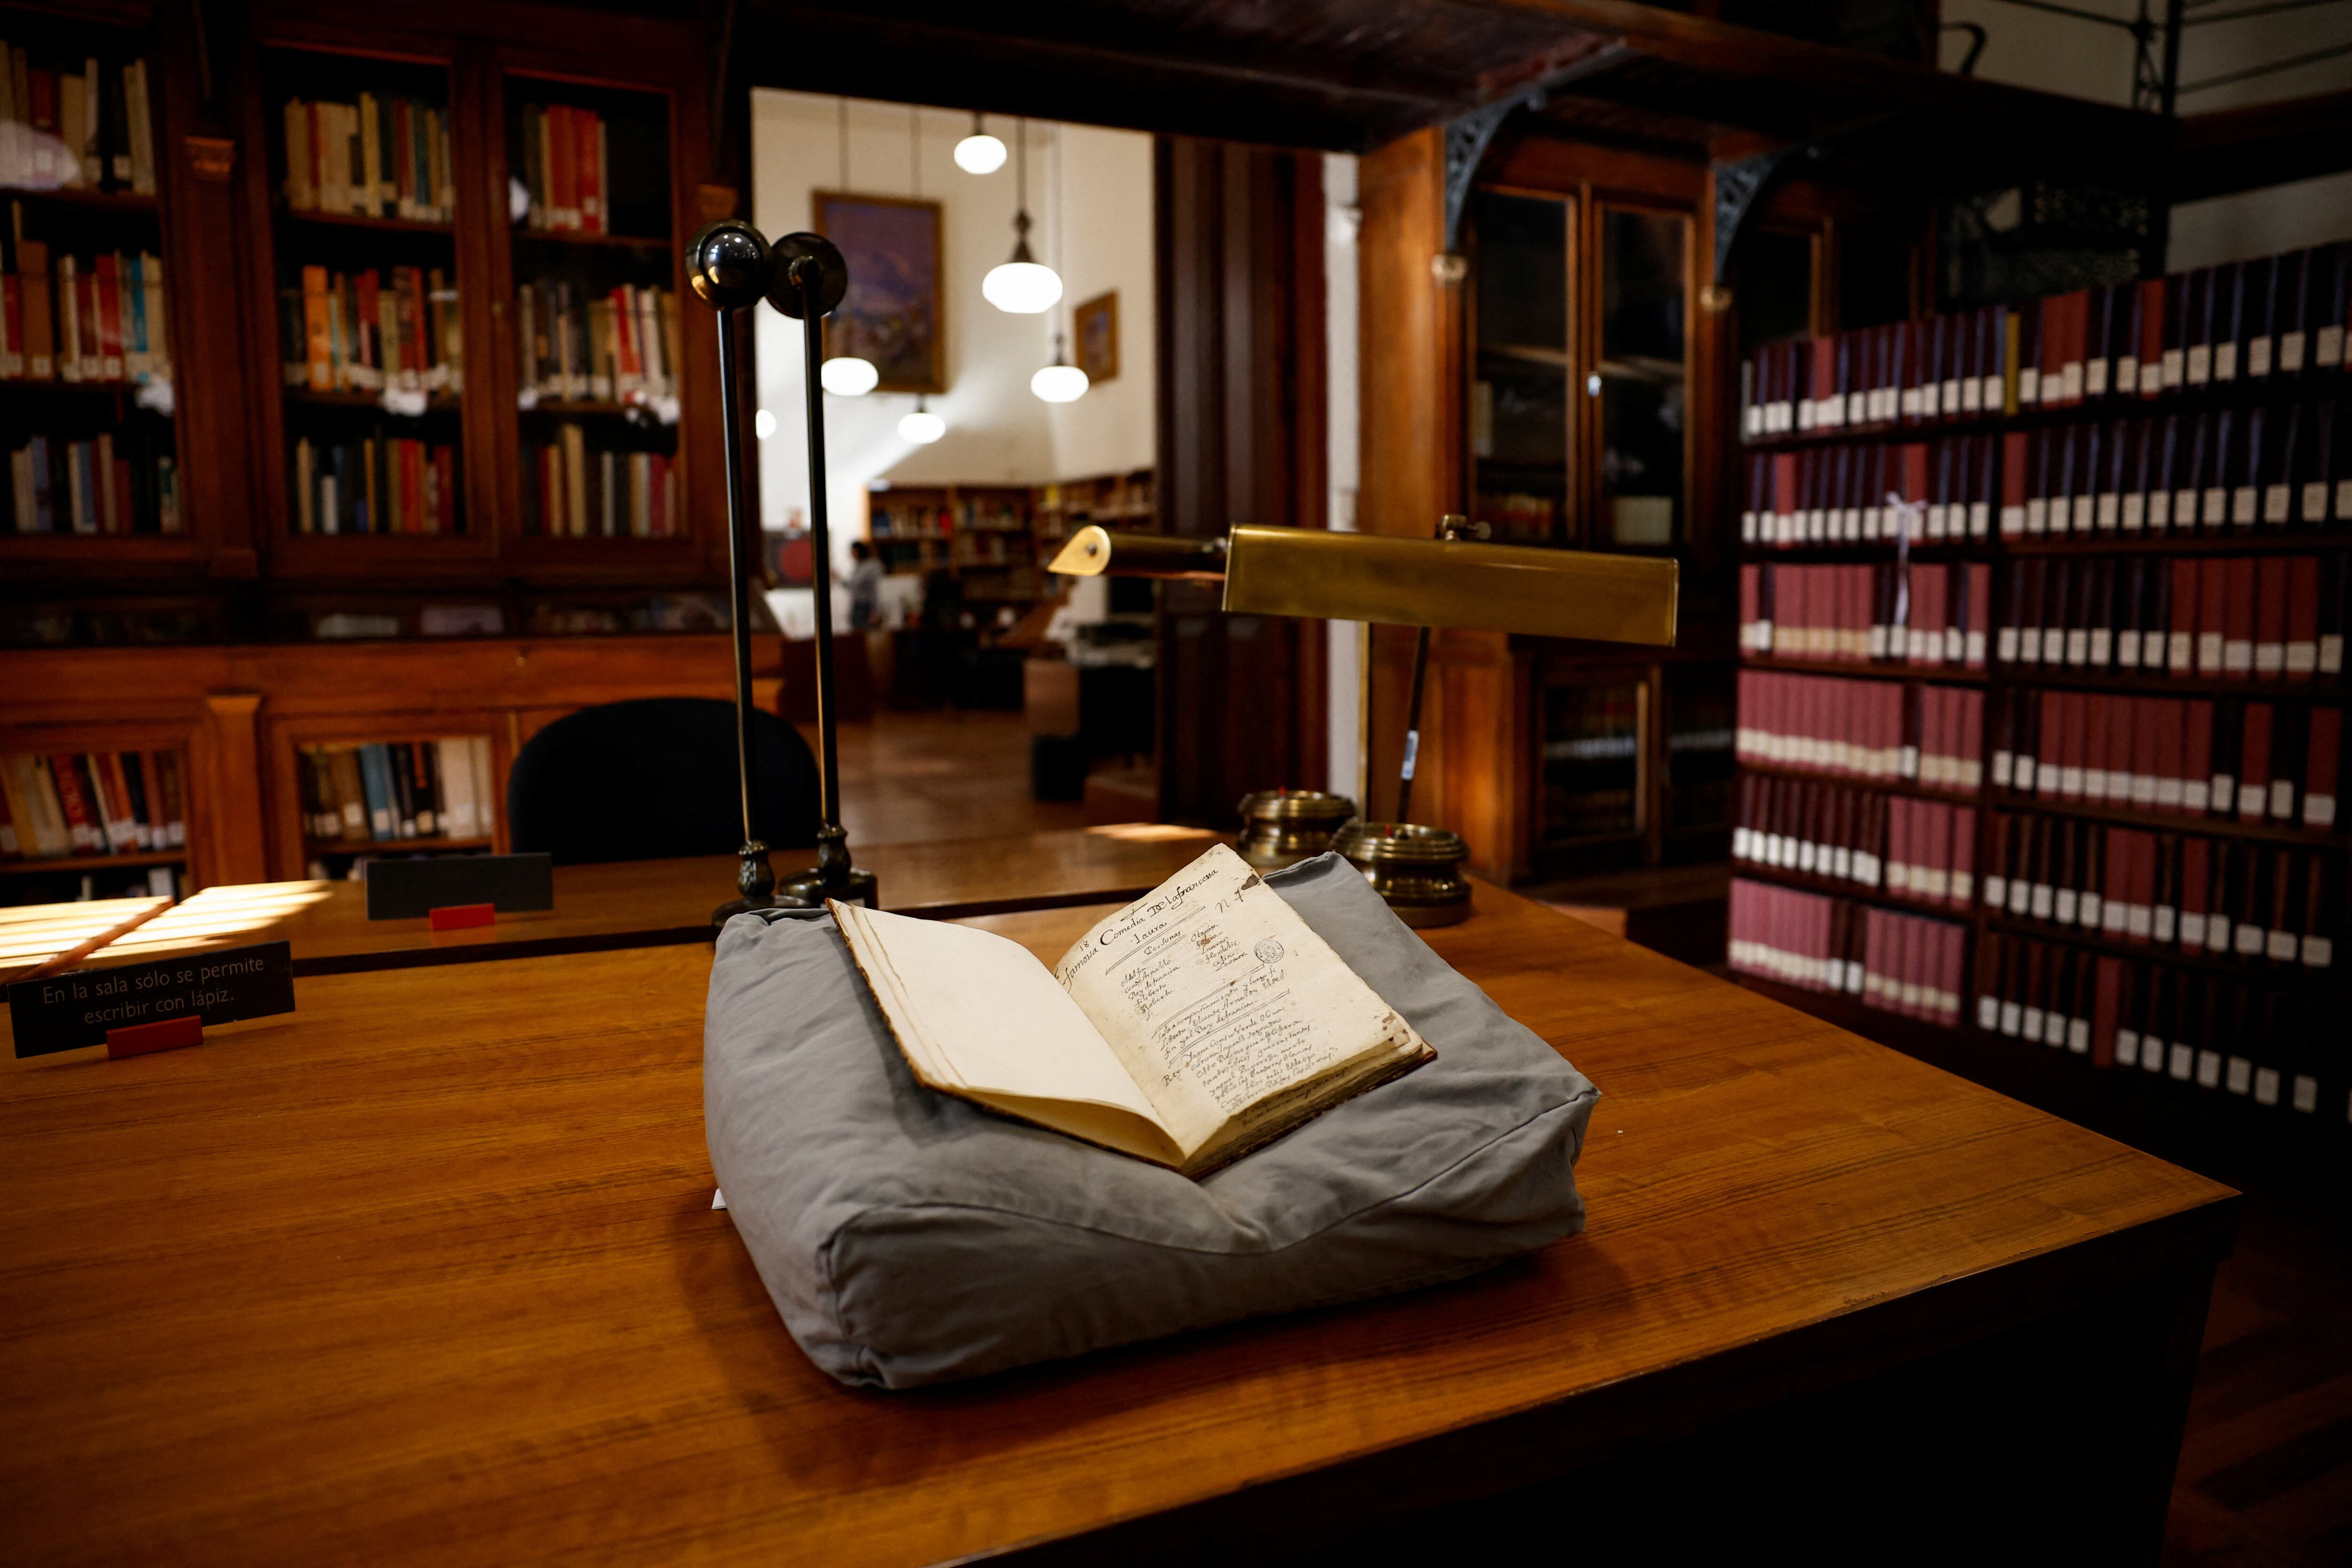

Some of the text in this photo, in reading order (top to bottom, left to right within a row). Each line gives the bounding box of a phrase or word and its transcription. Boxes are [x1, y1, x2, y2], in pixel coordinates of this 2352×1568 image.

[1100, 918, 1146, 946] Comedia
[43, 958, 264, 1004] En la sala sólo se permite
[84, 988, 234, 1024] escribir con lápiz.
